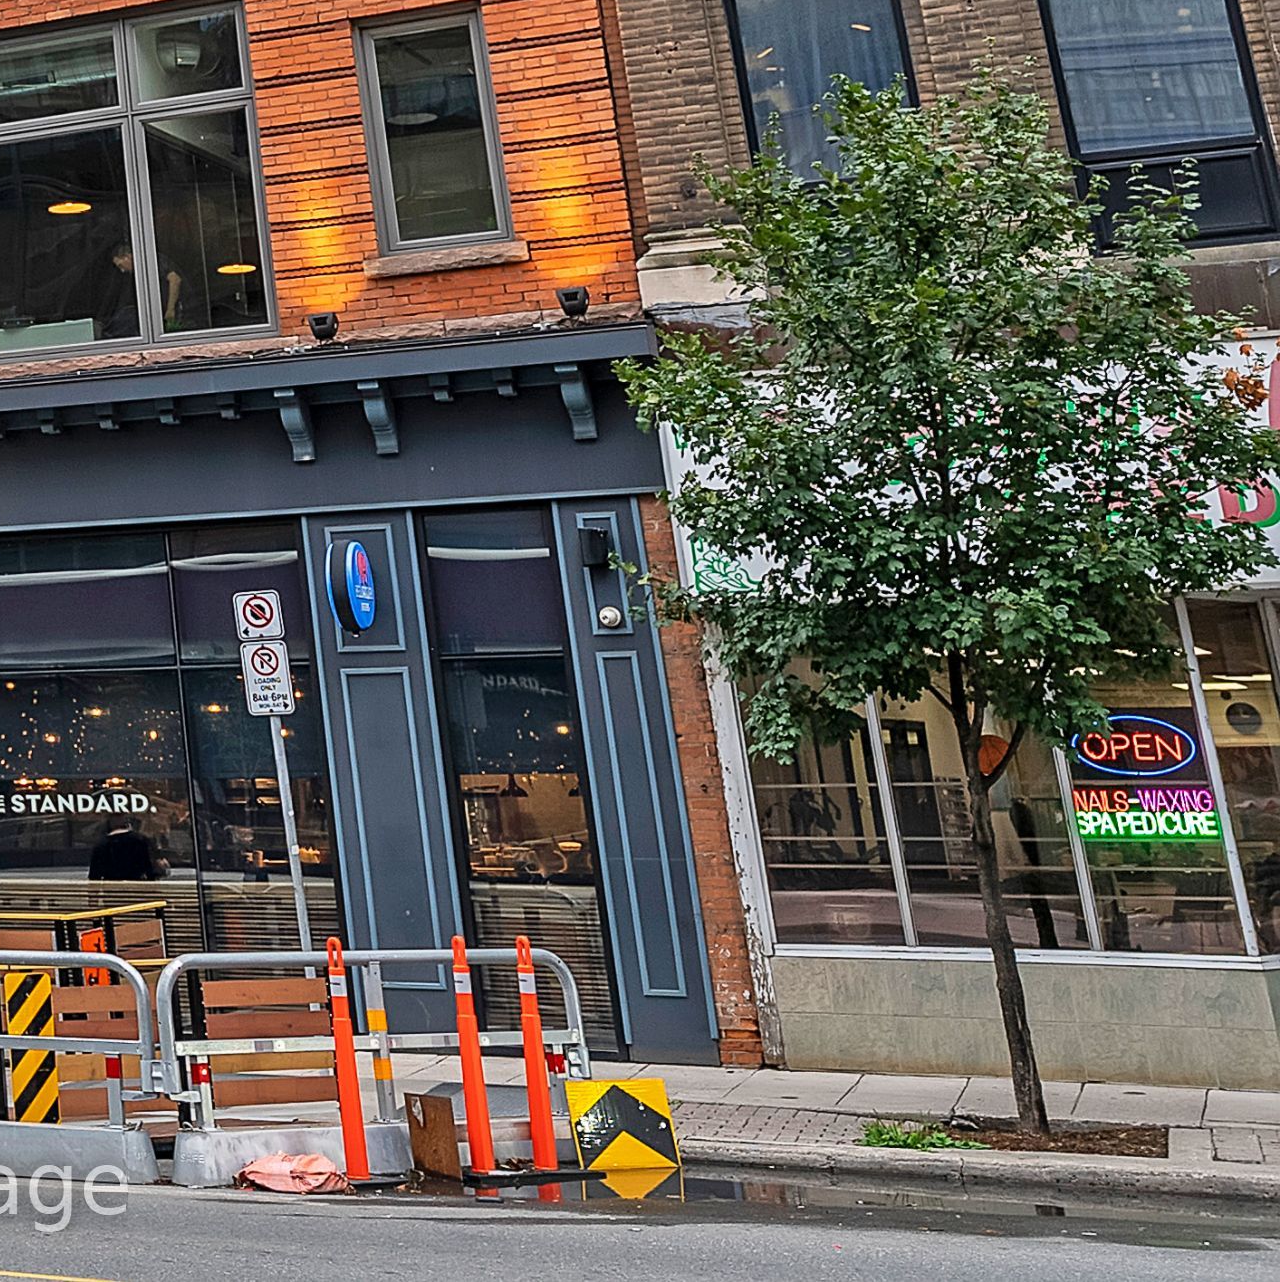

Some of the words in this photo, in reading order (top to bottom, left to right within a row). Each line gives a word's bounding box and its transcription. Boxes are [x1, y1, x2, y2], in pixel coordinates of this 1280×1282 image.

[254, 677, 282, 685] LOADING
[1083, 732, 1183, 762] OPEN
[10, 793, 158, 814] STANDARD.
[1076, 811, 1117, 836] SPA
[1117, 811, 1219, 836] PEDICURE
